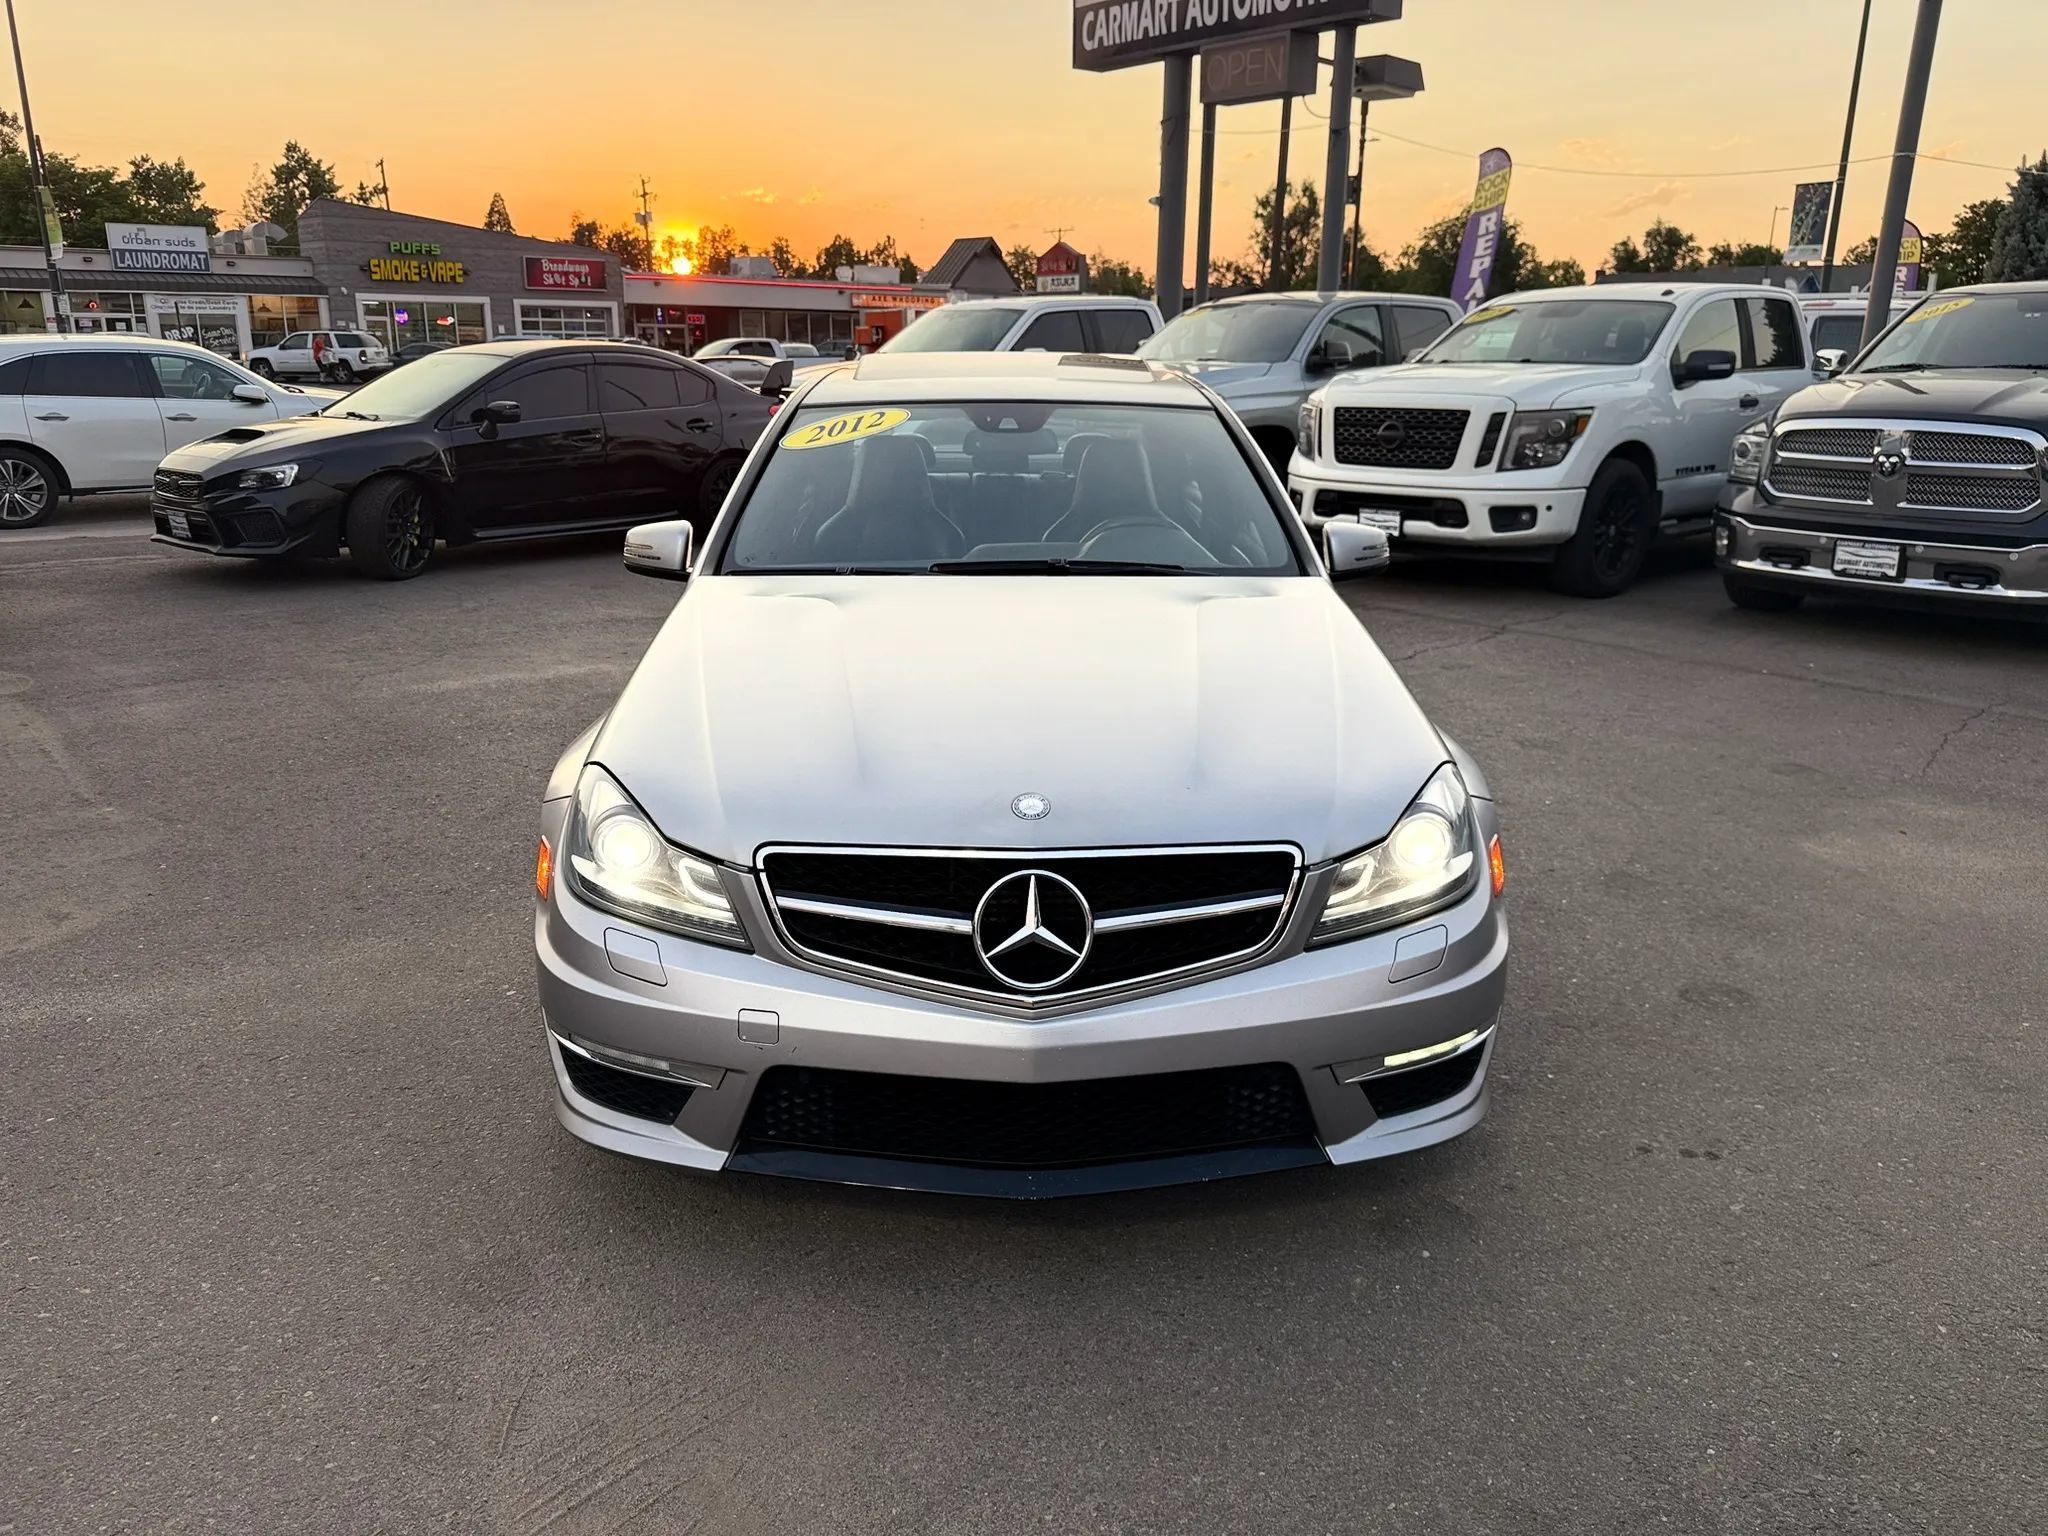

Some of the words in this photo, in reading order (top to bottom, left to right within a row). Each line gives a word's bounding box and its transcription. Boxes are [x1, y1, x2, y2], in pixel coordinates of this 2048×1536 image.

[1082, 0, 1180, 50] CARMART
[1206, 46, 1284, 92] OPEN
[1477, 171, 1509, 194] ROCK
[1474, 187, 1505, 209] CHIP
[165, 236, 196, 248] suds
[389, 241, 441, 255] PUFFS
[116, 250, 206, 270] LAUNDROMAT
[370, 258, 419, 282] SMOKE
[420, 263, 428, 278] &
[428, 260, 464, 283] VAPE
[1464, 211, 1498, 314] REPAI
[804, 411, 886, 445] 2012
